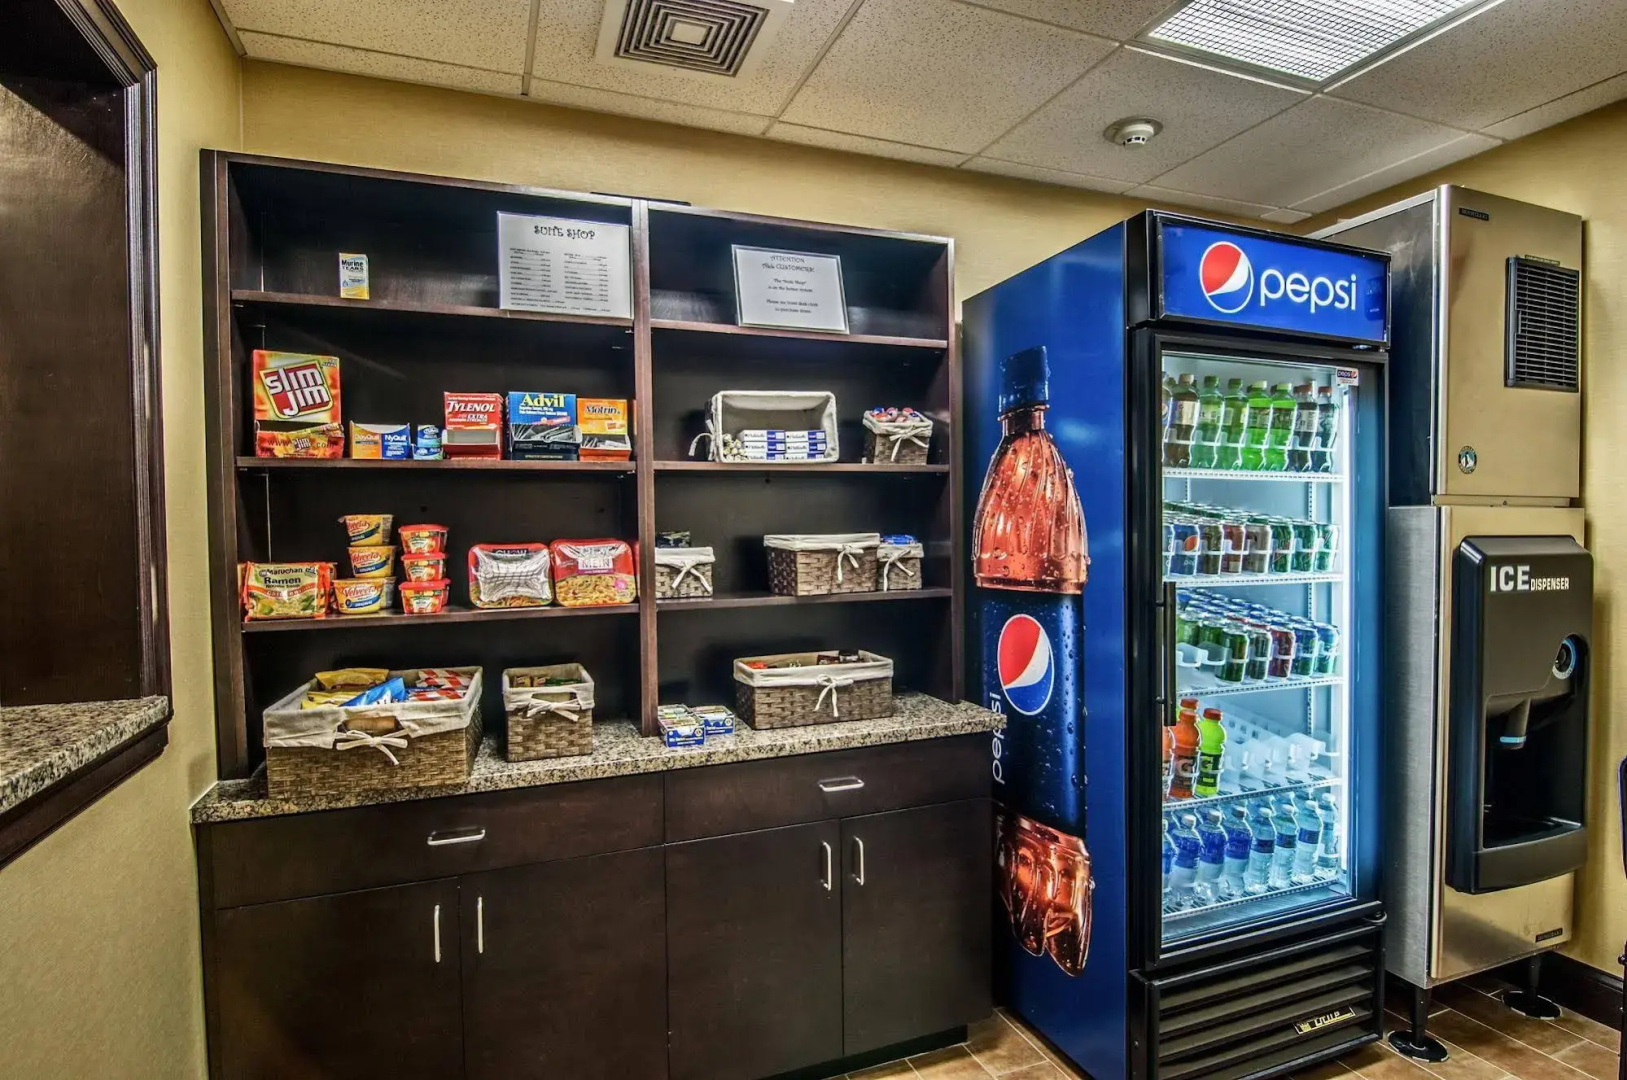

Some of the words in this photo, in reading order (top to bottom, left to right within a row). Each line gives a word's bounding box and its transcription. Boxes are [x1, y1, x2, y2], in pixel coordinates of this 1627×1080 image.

[534, 225, 563, 237] SUITE
[567, 228, 596, 240] SHOP
[341, 259, 364, 267] Murine
[1260, 269, 1357, 314] pepsi
[520, 393, 565, 407] Advil
[447, 401, 496, 412] TYLENOL
[586, 405, 617, 414] Motrin
[354, 434, 379, 442] DayQuil
[384, 434, 407, 442] NyQuil
[582, 559, 610, 569] MEIN
[266, 567, 303, 576] Maruchan
[264, 577, 301, 585] Ramen
[1490, 565, 1530, 592] ICE
[1530, 577, 1570, 591] DISPENSER
[344, 586, 377, 598] Velveeta
